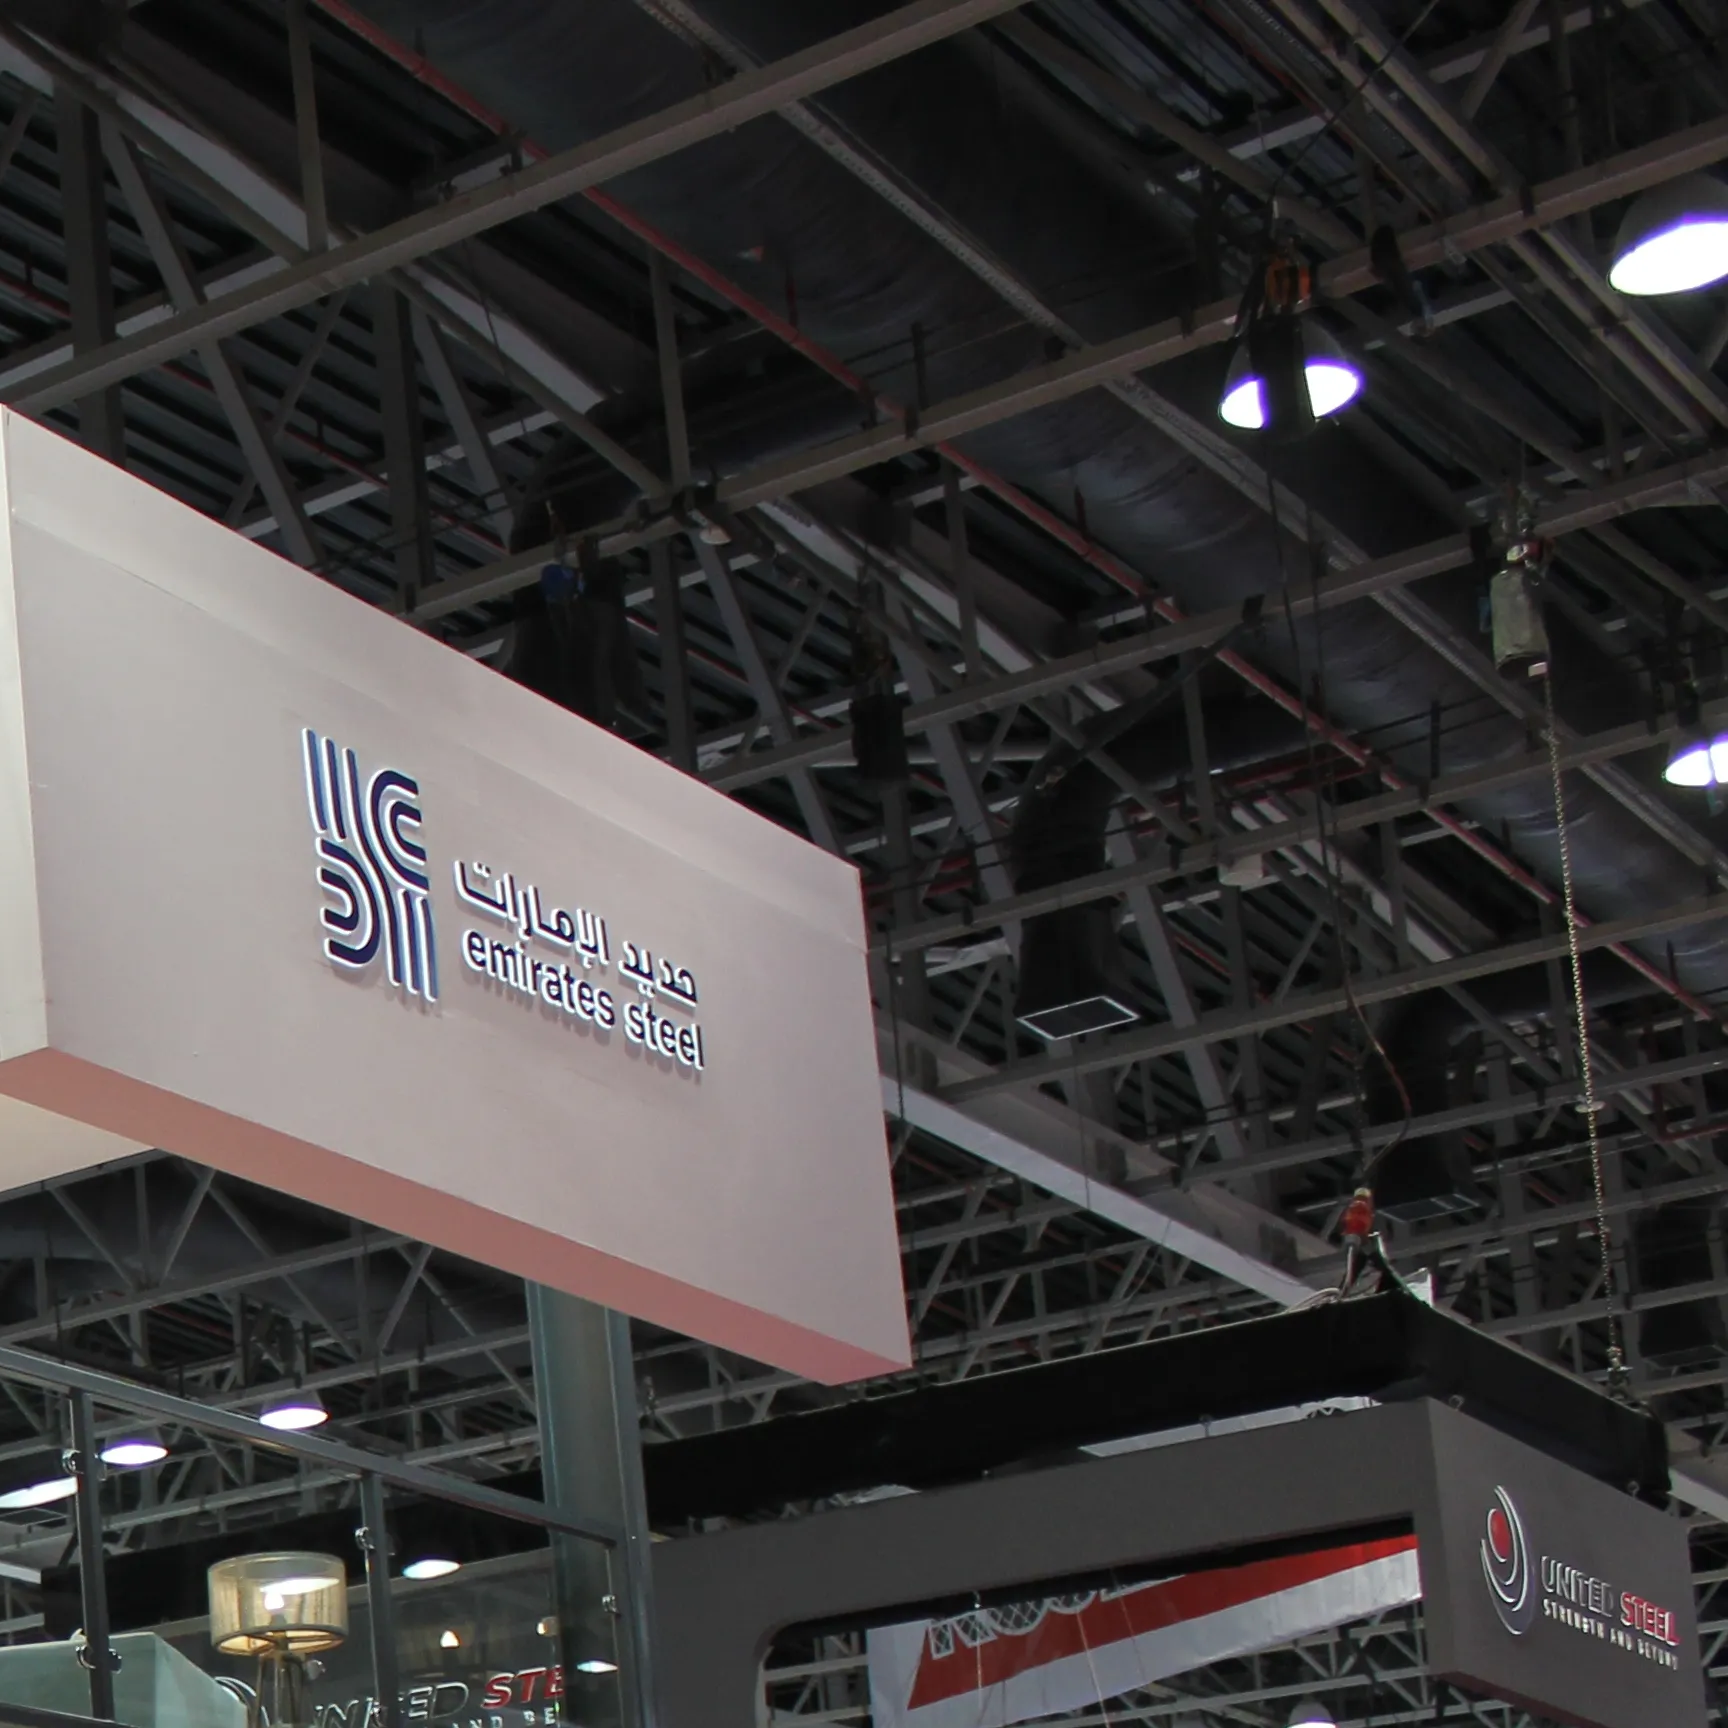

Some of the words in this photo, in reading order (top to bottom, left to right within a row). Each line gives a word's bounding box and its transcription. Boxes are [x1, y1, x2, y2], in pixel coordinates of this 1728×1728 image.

[453, 860, 609, 969] الإمارات
[462, 929, 616, 1030] emirates
[622, 1000, 704, 1070] steel
[618, 940, 698, 1007] حديد
[1541, 1555, 1614, 1618] UNITED
[1620, 1591, 1681, 1647] STEEL
[481, 1664, 565, 1709] STE
